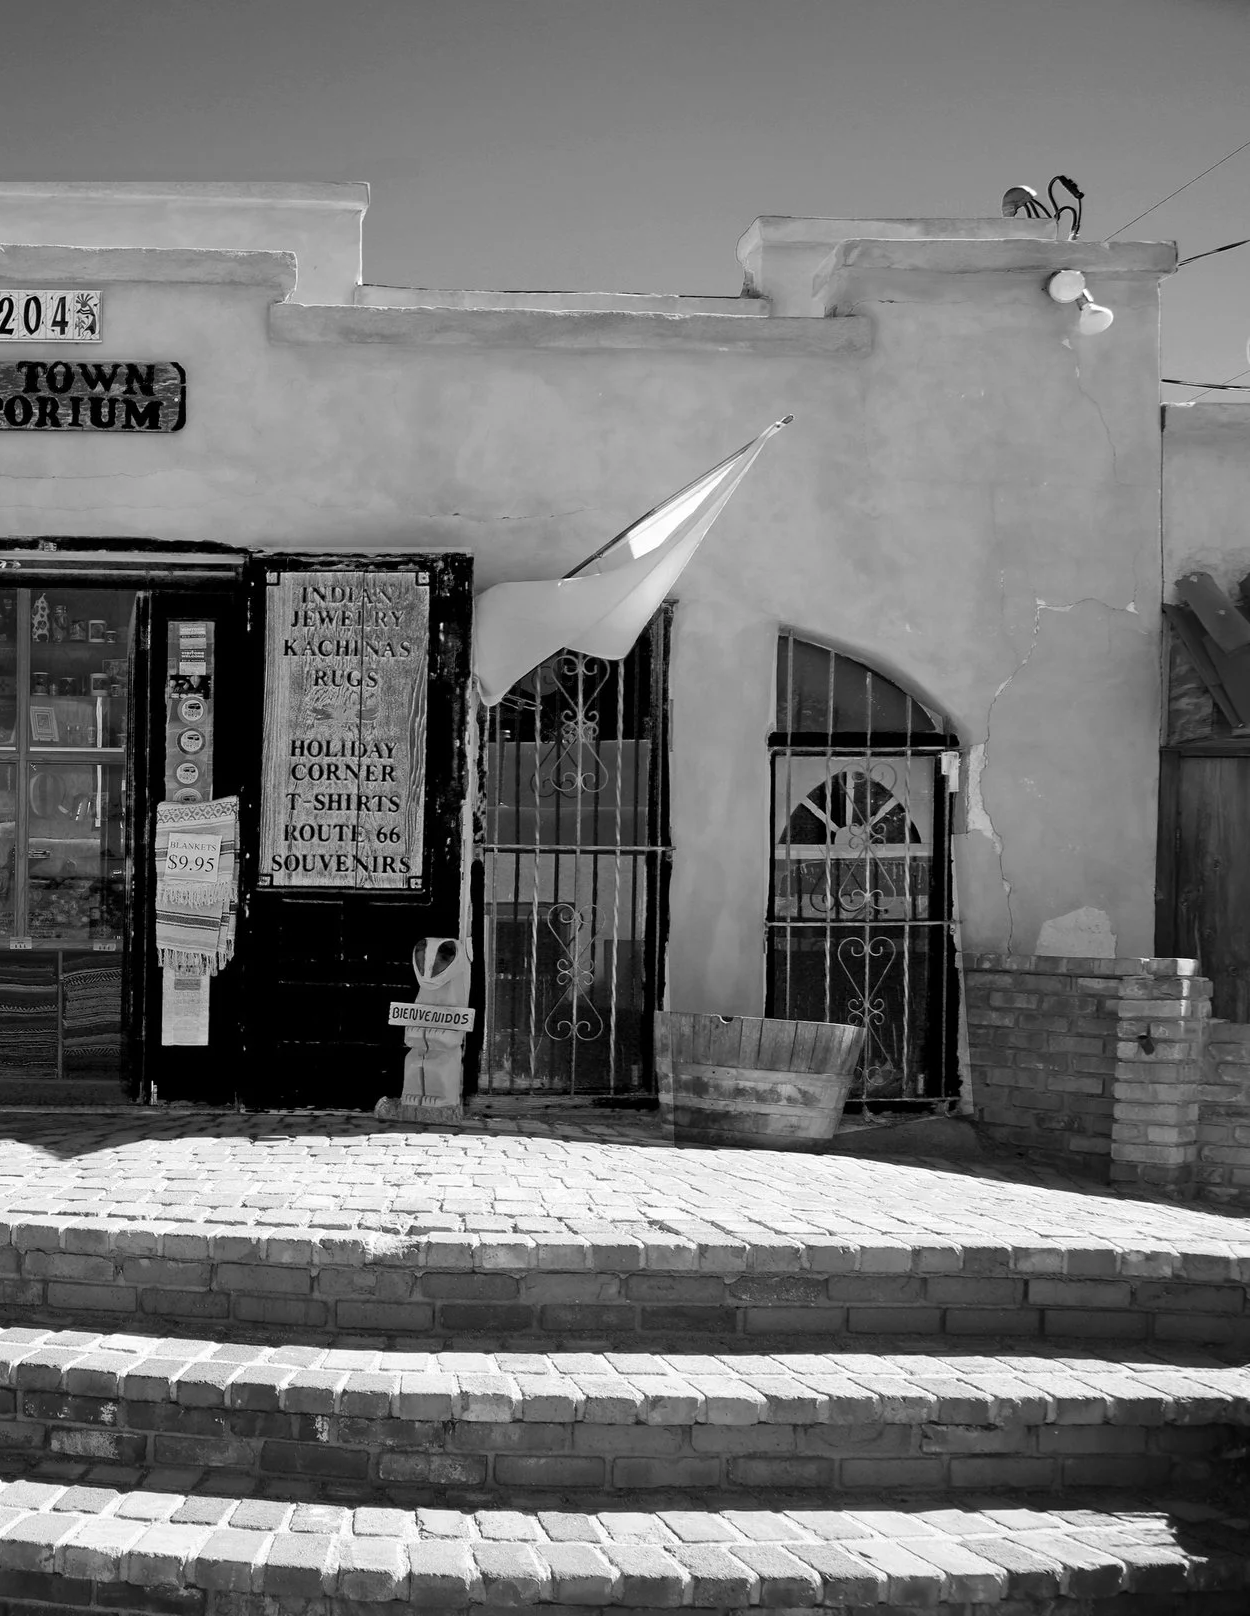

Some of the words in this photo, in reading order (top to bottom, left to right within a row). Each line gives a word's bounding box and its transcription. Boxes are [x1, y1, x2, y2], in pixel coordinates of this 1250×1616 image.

[16, 361, 157, 396] TOWN
[301, 586, 395, 605] INDIAN
[291, 610, 406, 629] JEWELRY
[282, 639, 412, 658] KACHINAS
[313, 669, 379, 688] RUGS
[290, 739, 398, 759] HOLIDAY
[291, 764, 396, 782] CORNER
[285, 793, 400, 813] T-SHIRTS
[284, 824, 365, 843] ROUTE
[376, 826, 401, 843] 66
[170, 841, 217, 851] BLANKETS
[167, 854, 214, 873] $9.95
[271, 855, 411, 874] SOUVENIRS
[392, 1007, 469, 1025] BIENVENIDOS
